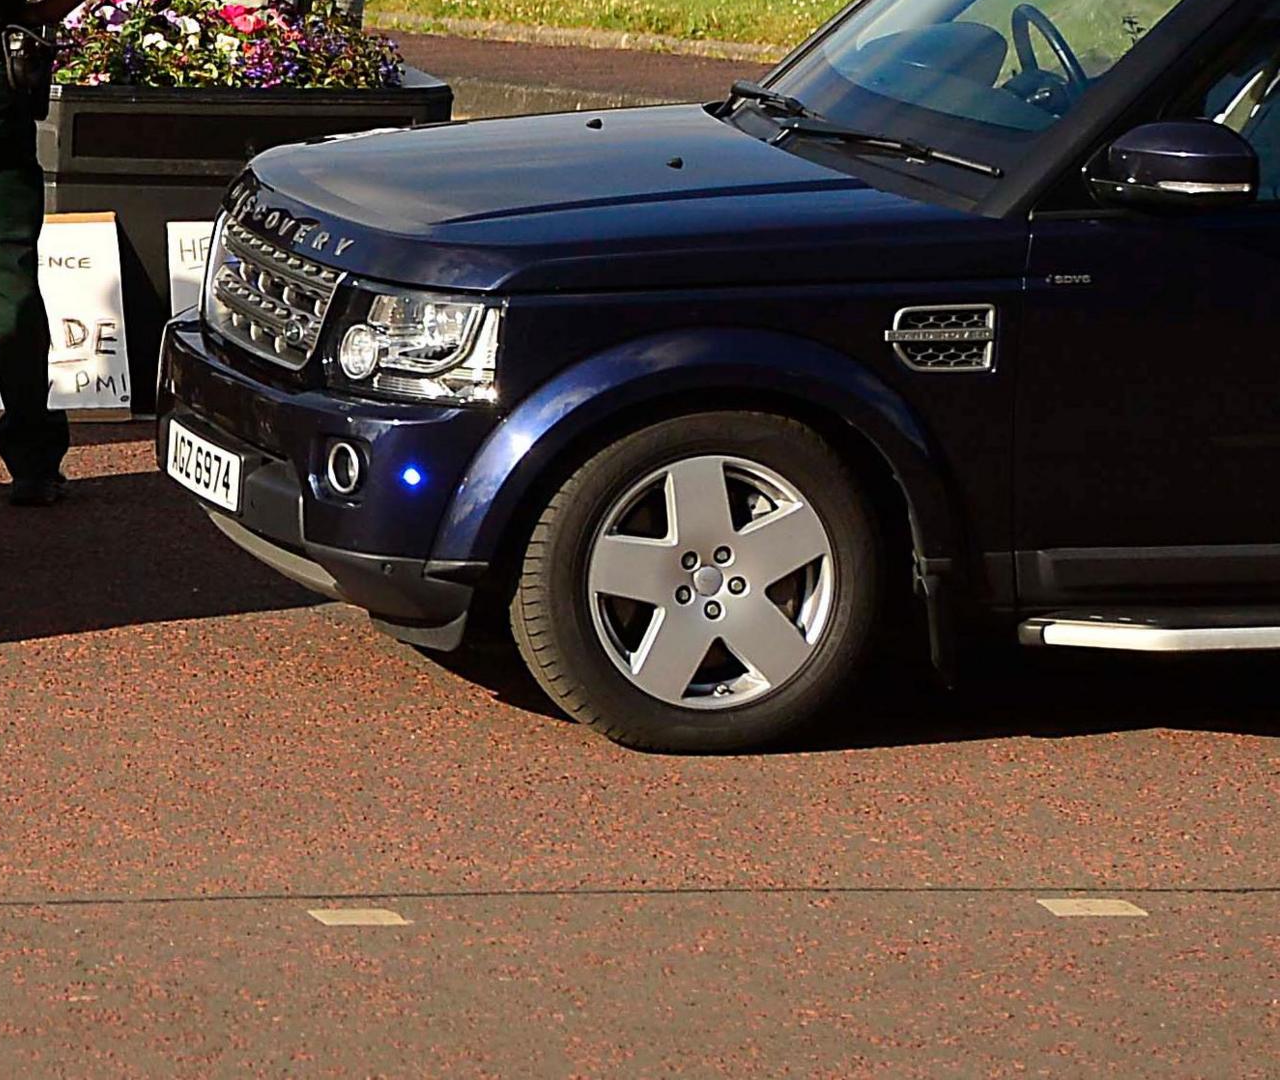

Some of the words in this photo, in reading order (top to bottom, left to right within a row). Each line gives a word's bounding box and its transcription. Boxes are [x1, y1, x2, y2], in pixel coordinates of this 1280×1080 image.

[76, 371, 130, 402] PM!
[172, 430, 193, 479] AGZ
[195, 446, 231, 500] 6974
